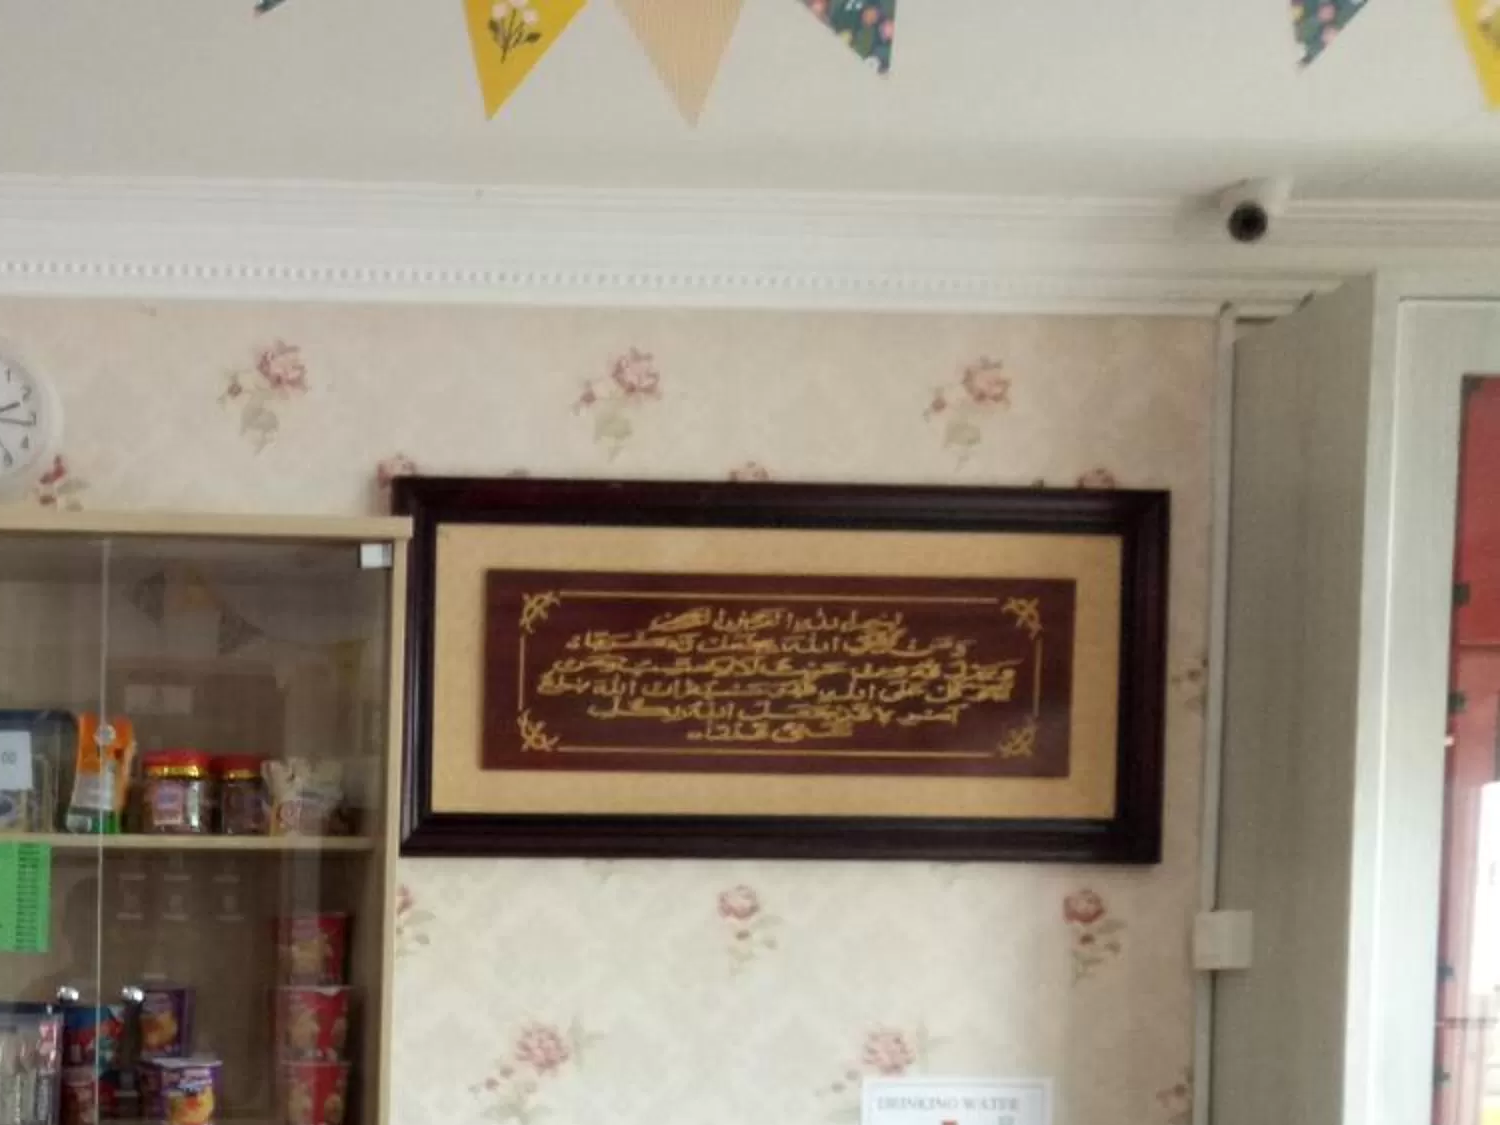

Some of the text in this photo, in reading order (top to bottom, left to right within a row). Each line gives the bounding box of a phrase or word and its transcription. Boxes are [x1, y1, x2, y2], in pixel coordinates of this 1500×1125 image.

[21, 386, 33, 402] 2
[876, 1095, 1022, 1112] DRINKING WATER
